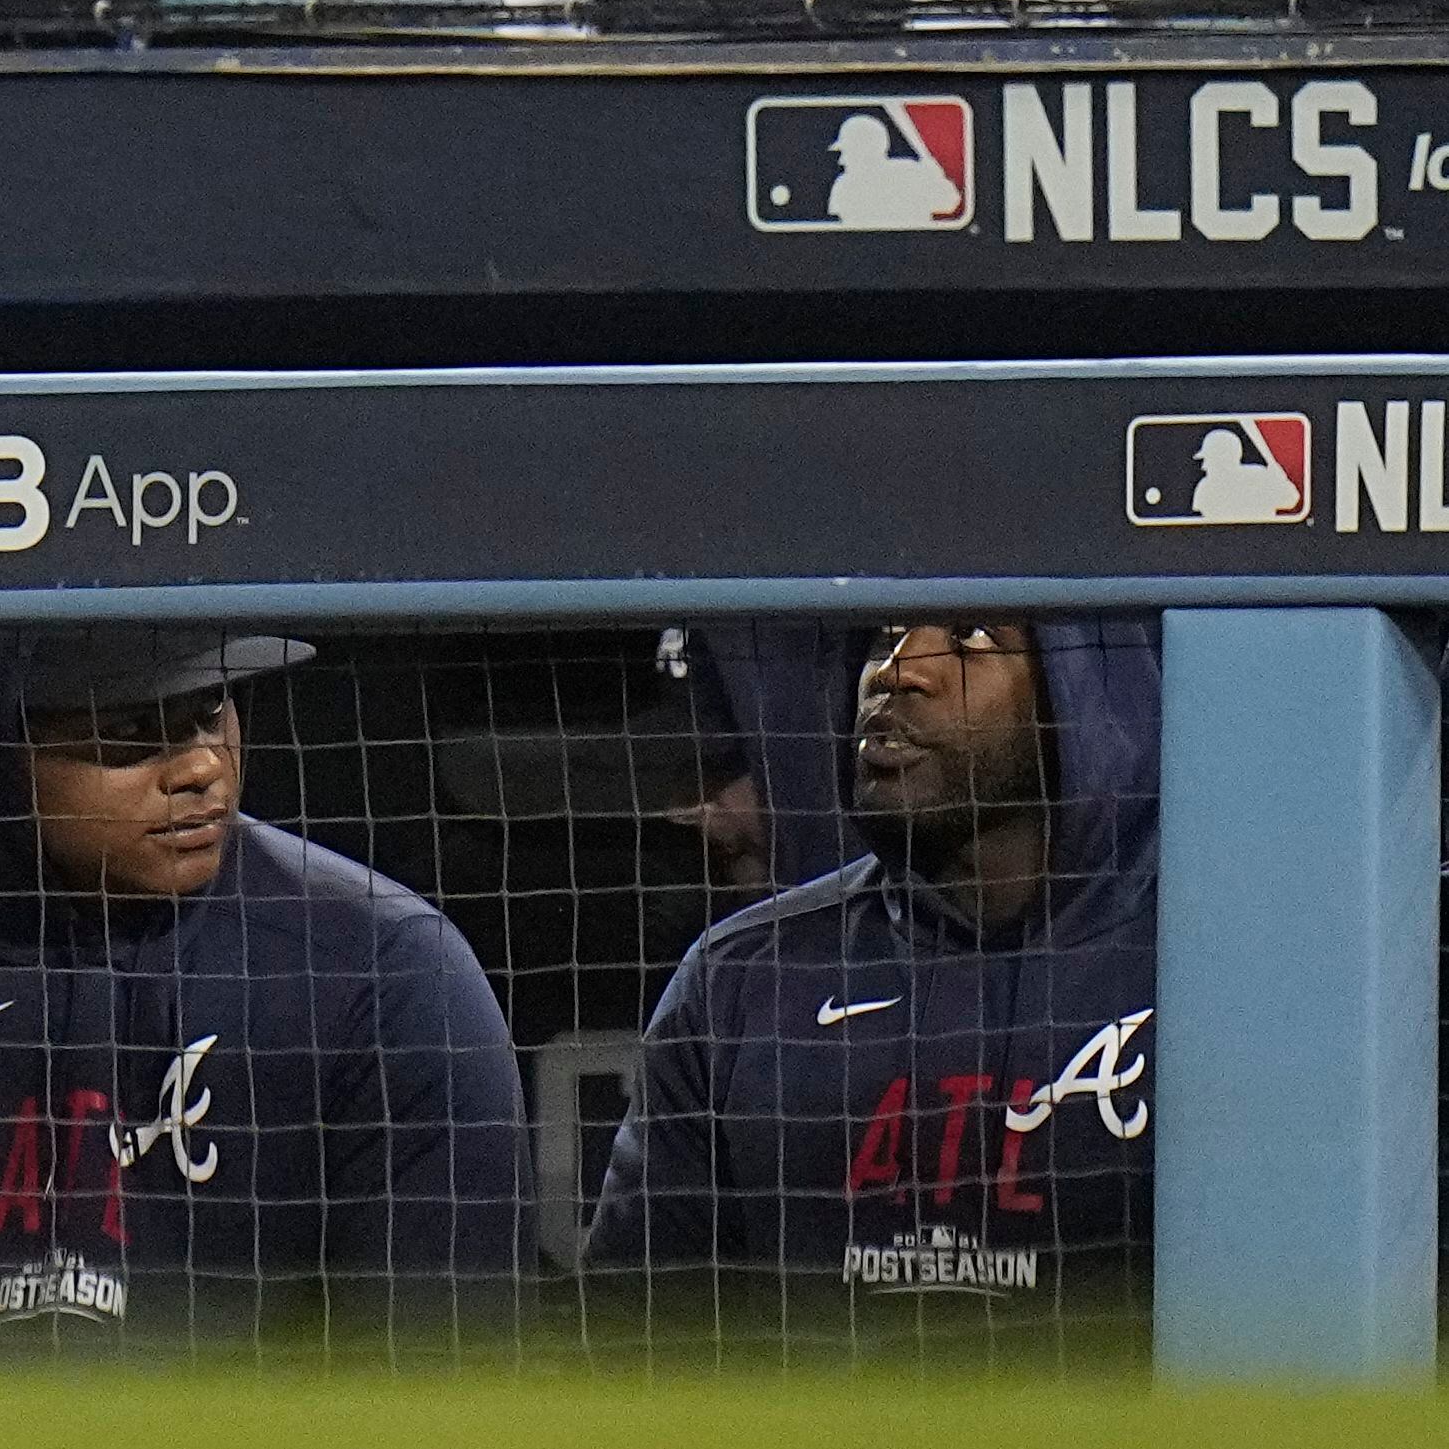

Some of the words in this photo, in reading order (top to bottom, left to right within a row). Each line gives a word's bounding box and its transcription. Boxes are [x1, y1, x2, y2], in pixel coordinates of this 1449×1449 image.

[1003, 81, 1379, 242] NLCS
[64, 453, 238, 545] App
[841, 1074, 1046, 1212] ATL
[842, 1244, 1039, 1289] POSTSEASON
